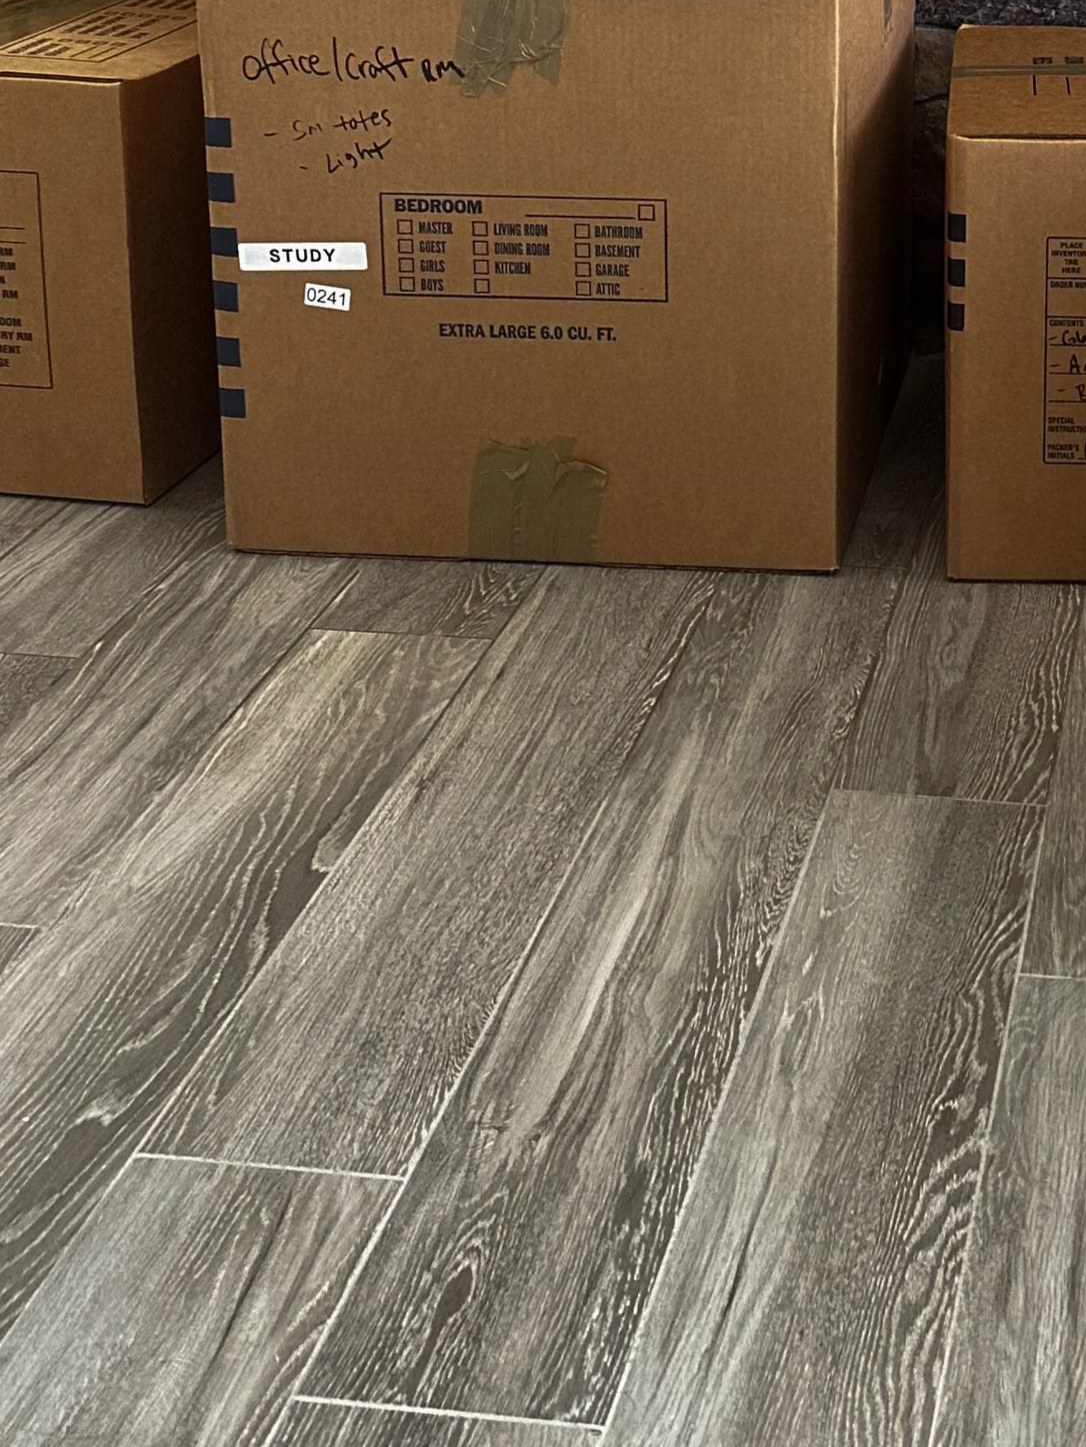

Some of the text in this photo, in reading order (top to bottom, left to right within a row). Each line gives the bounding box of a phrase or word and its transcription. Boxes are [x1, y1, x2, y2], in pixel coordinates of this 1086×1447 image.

[394, 198, 483, 214] BEDROOM
[418, 221, 453, 235] MASTER
[494, 223, 548, 237] LIVING ROOM
[594, 226, 643, 240] BATHROOM
[419, 240, 446, 254] GUEST
[494, 242, 550, 256] DINING ROOM
[595, 244, 641, 258] BASEMENT
[269, 248, 336, 263] STUDY
[420, 259, 445, 273] GIRLS
[494, 261, 531, 275] KITCHEN
[595, 263, 630, 277] GARAGE
[421, 278, 444, 292] BOYS
[596, 282, 620, 296] ATTIC
[307, 287, 346, 306] 0241
[439, 323, 617, 342] EXTRA LARGE 6.0 CU. FT.
